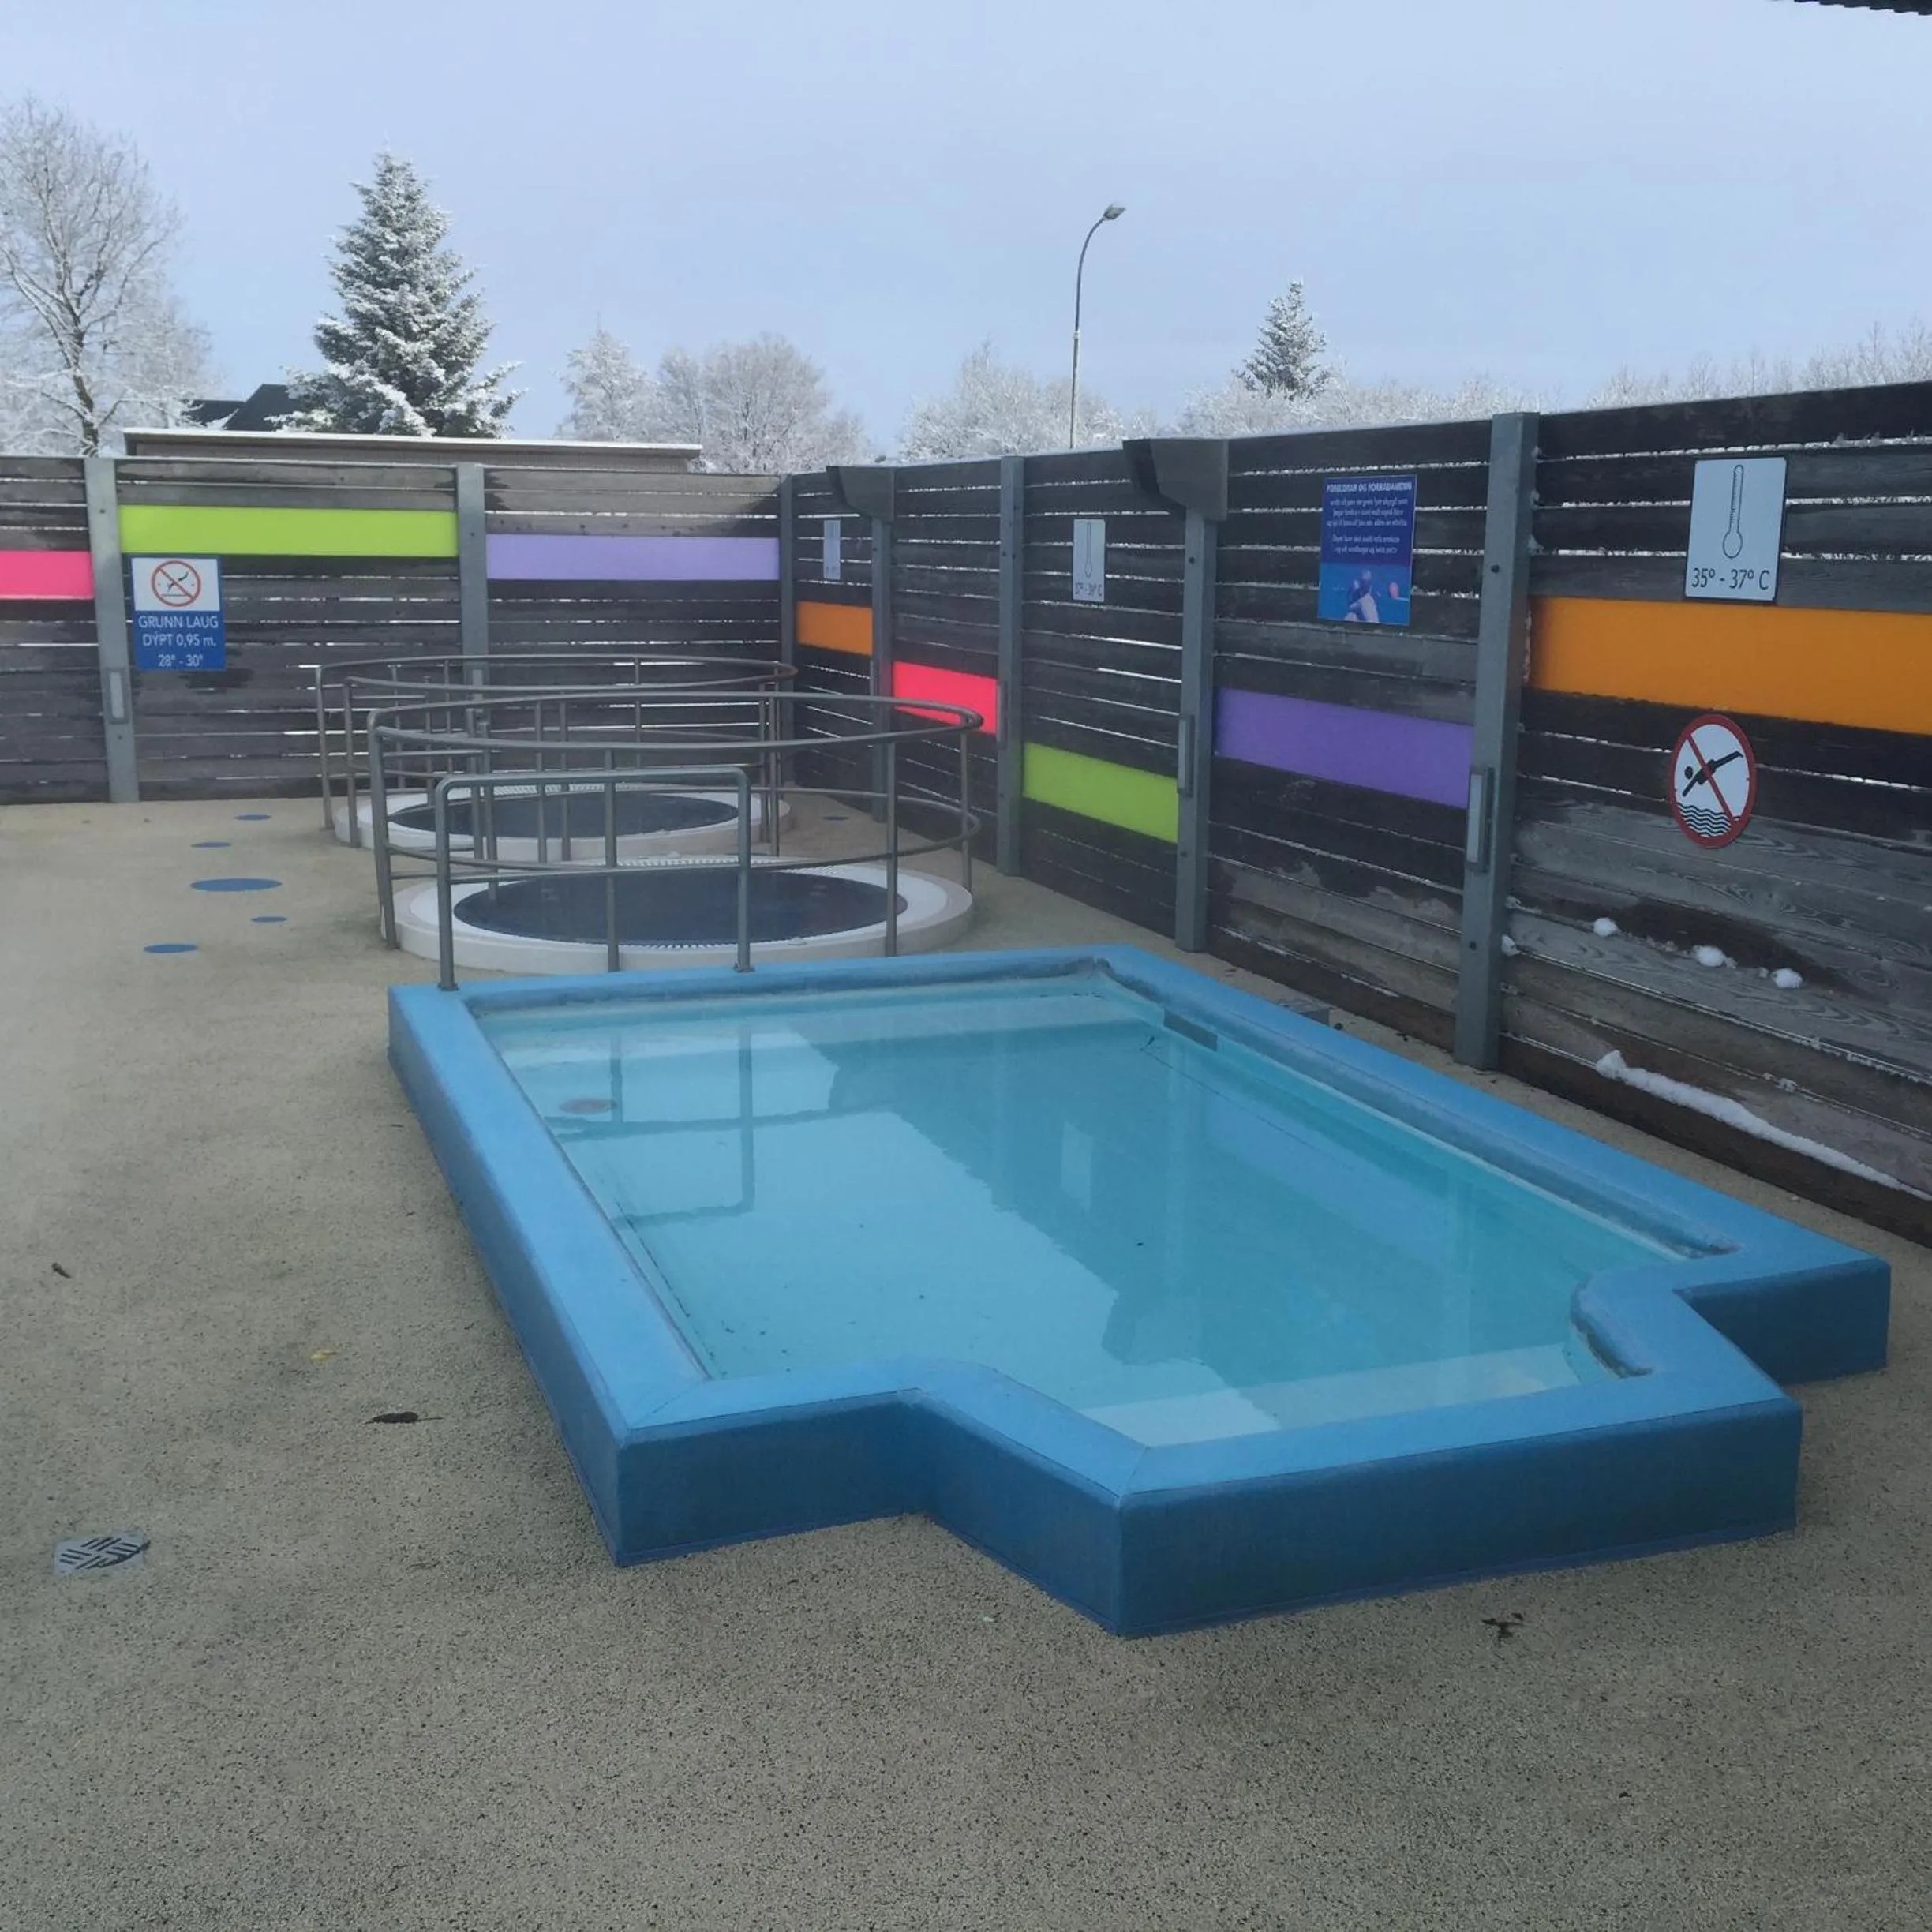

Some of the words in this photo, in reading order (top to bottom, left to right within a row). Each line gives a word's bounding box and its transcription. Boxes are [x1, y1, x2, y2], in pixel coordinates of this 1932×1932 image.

[1758, 569, 1770, 590] C
[138, 615, 183, 628] GRUNN
[186, 615, 219, 628] LAUG
[142, 631, 173, 646] DÝPT
[176, 633, 200, 647] 0,95
